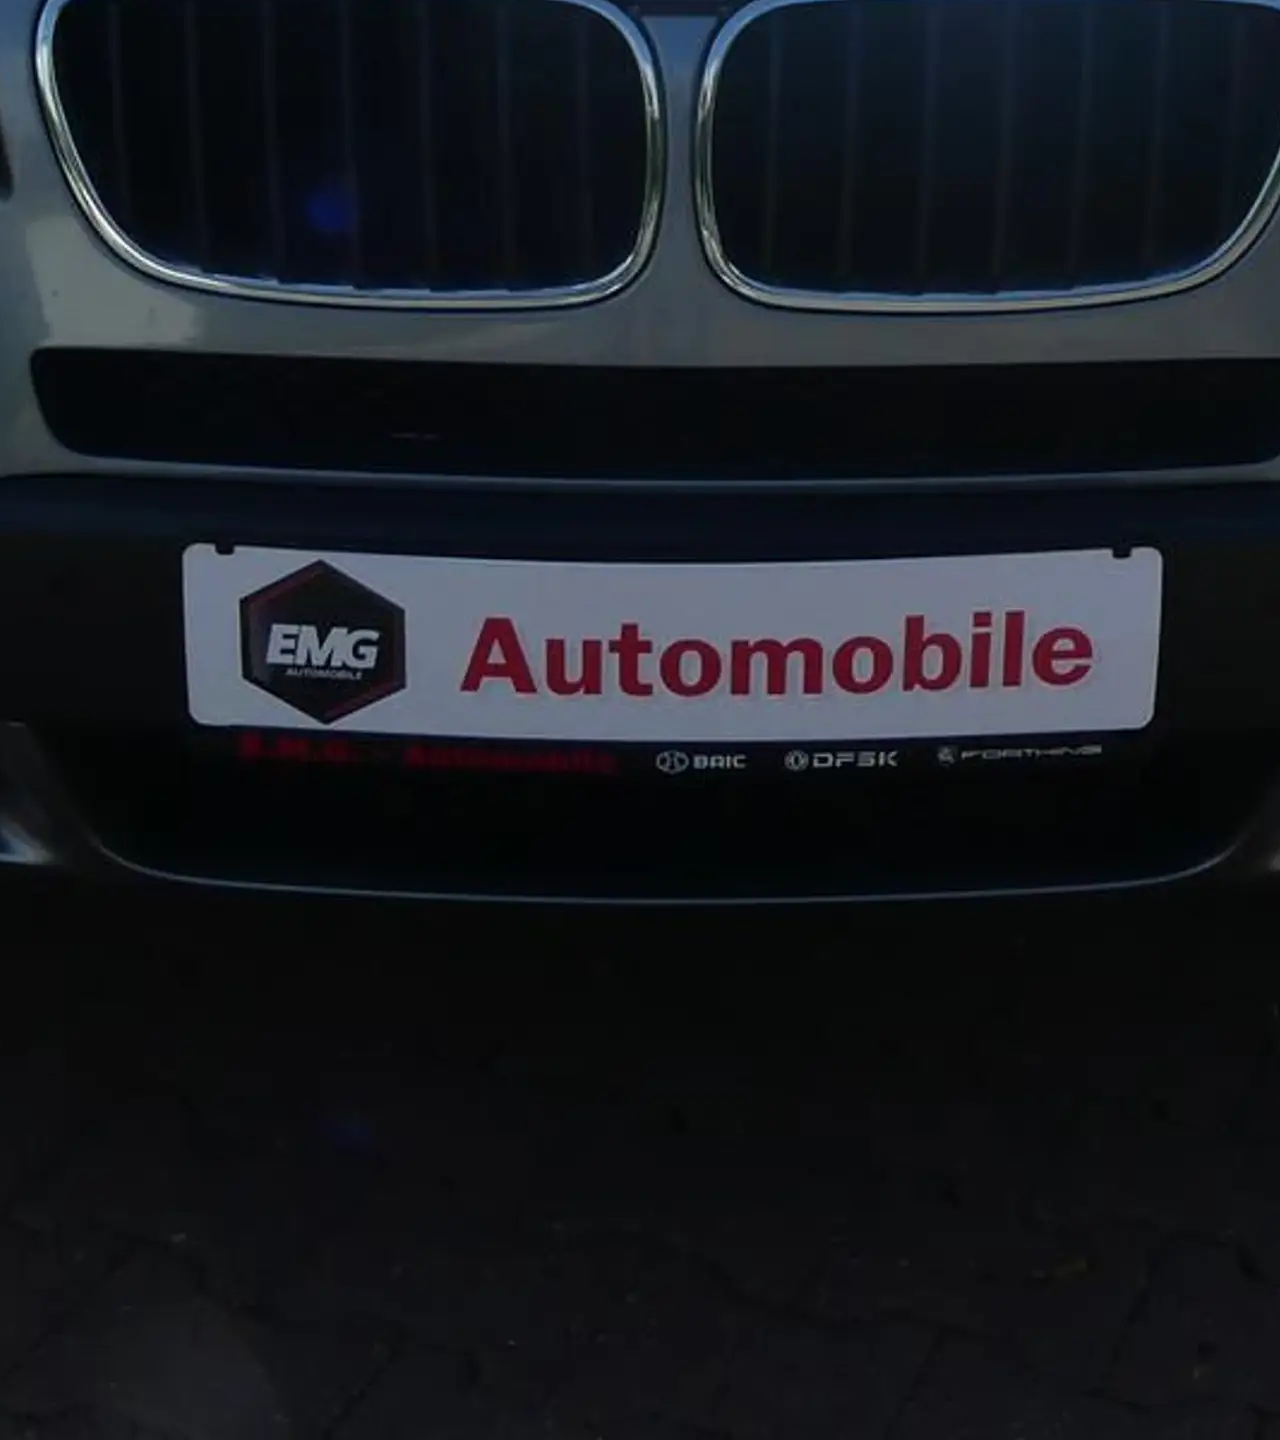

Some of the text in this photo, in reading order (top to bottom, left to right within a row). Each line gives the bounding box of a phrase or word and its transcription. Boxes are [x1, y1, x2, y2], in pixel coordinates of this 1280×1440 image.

[265, 622, 380, 670] EMG
[461, 611, 1093, 695] Automobile
[284, 666, 363, 681] AUTOMOBILE
